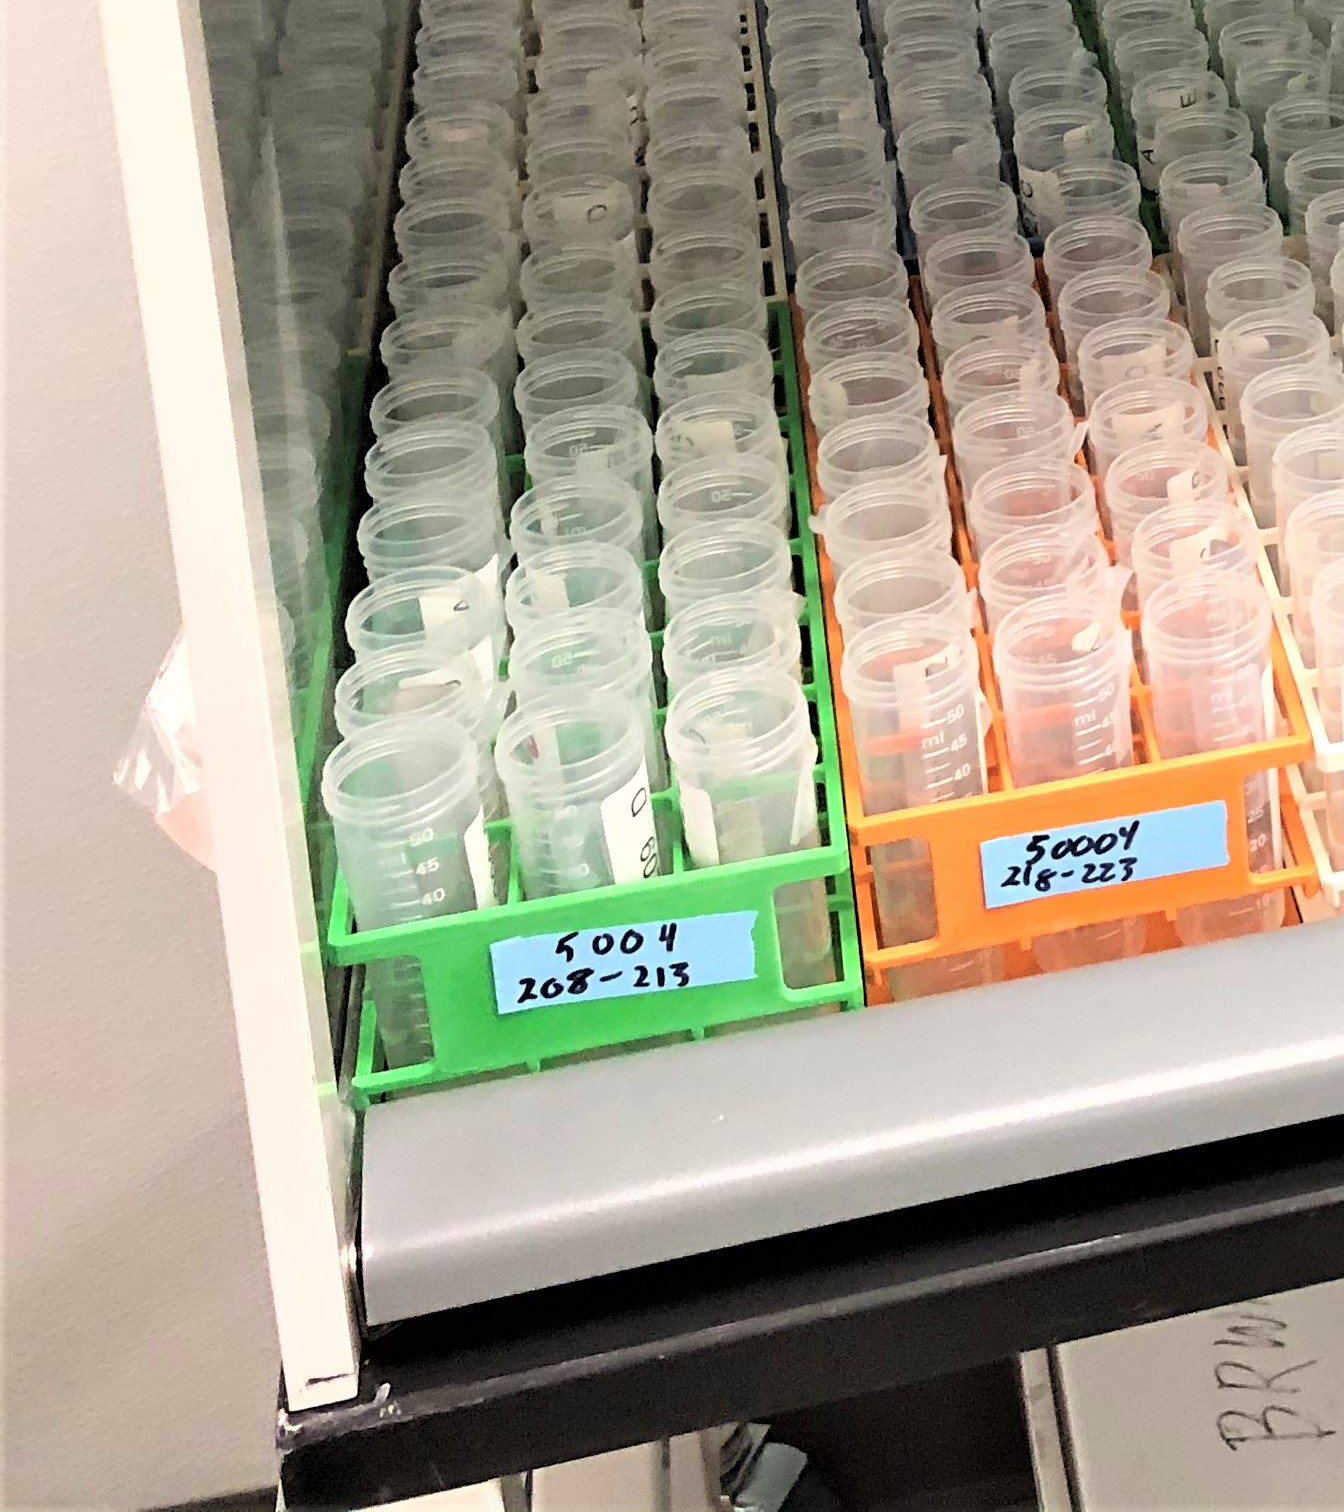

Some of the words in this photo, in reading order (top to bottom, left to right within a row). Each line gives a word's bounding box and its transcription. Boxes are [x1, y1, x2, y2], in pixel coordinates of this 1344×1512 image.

[1026, 820, 1140, 865] 50004
[416, 857, 440, 875] 45
[1001, 857, 1138, 892] 218-223
[422, 888, 446, 906] 40
[555, 922, 677, 962] 5004
[517, 961, 690, 1003] 208-213
[1212, 1300, 1337, 1452] BRW
